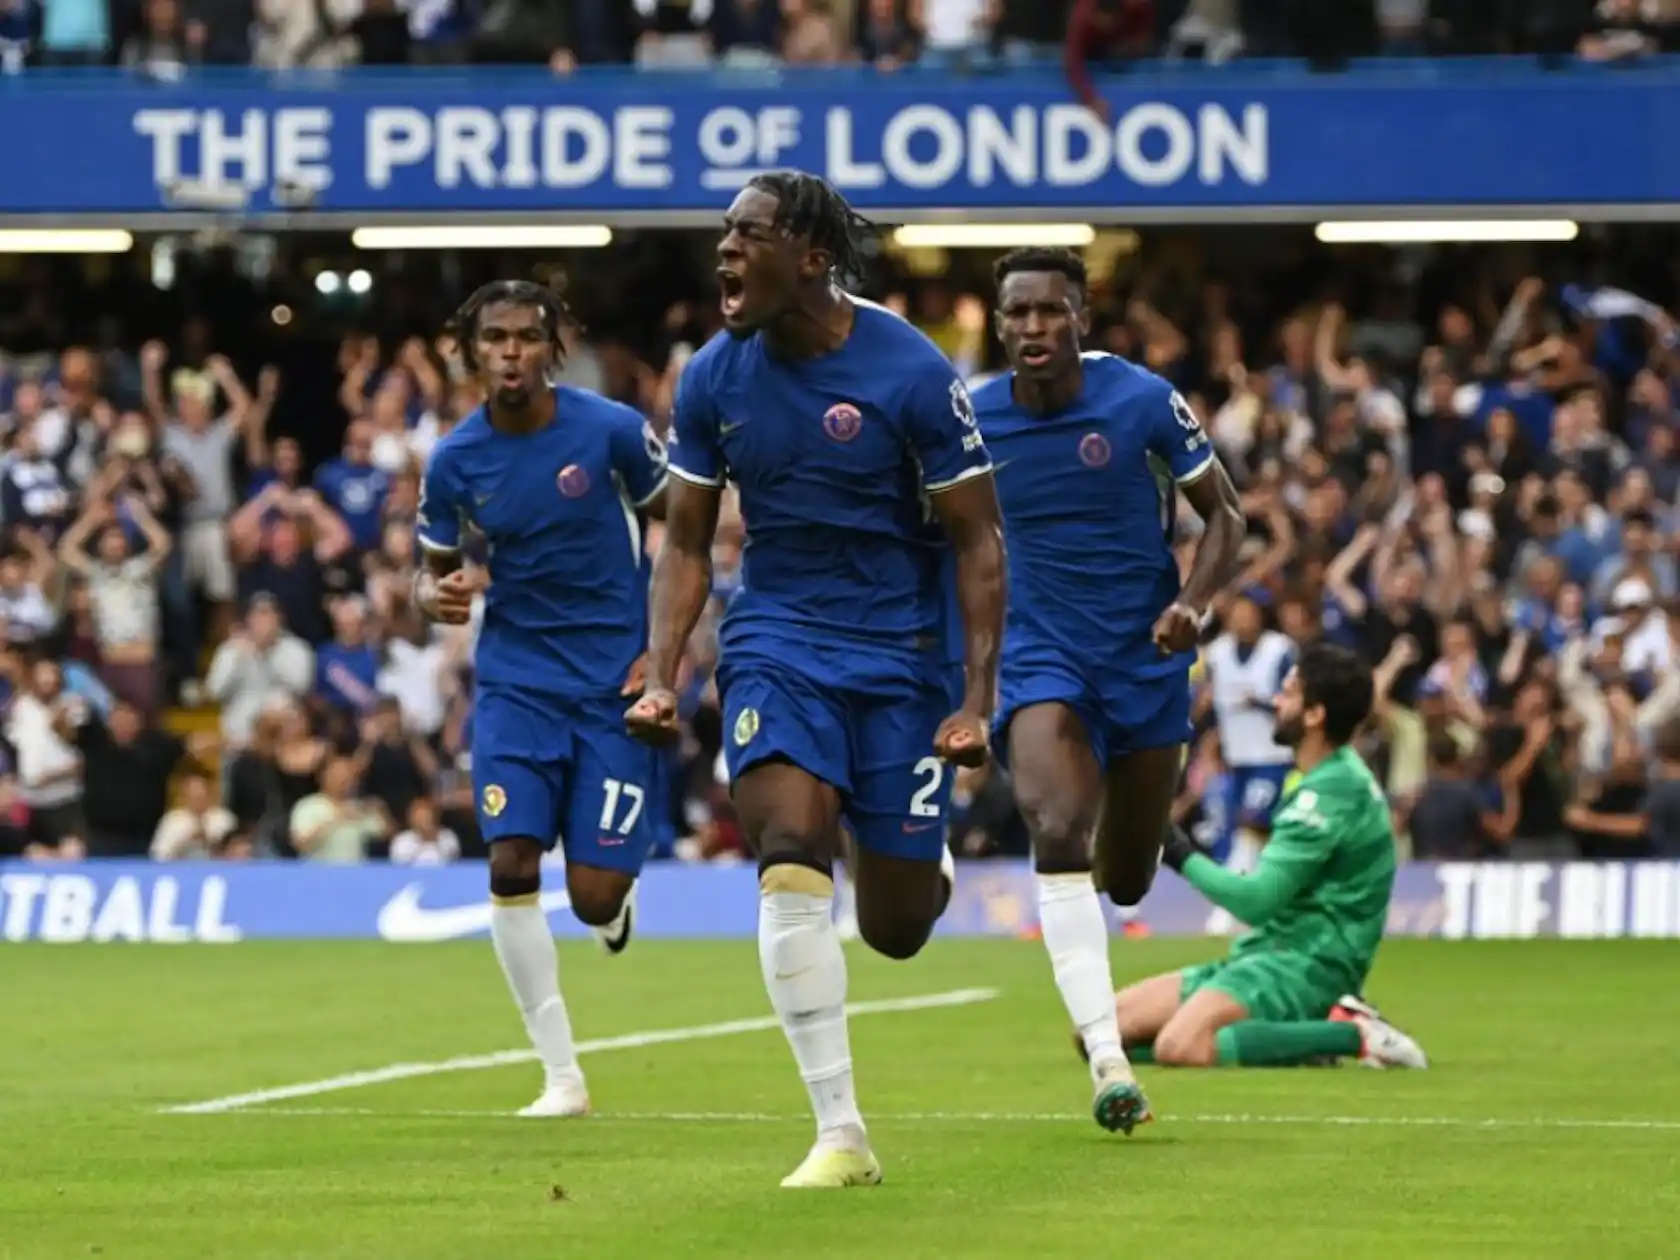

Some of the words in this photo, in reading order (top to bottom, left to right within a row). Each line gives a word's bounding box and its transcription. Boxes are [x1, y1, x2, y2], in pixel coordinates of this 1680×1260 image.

[132, 107, 333, 190] THE
[364, 105, 674, 188] PRIDE
[698, 105, 801, 166] OF
[825, 102, 1269, 188] LONDON
[599, 777, 645, 835] 17
[909, 756, 943, 817] 2
[0, 873, 243, 943] TBALL
